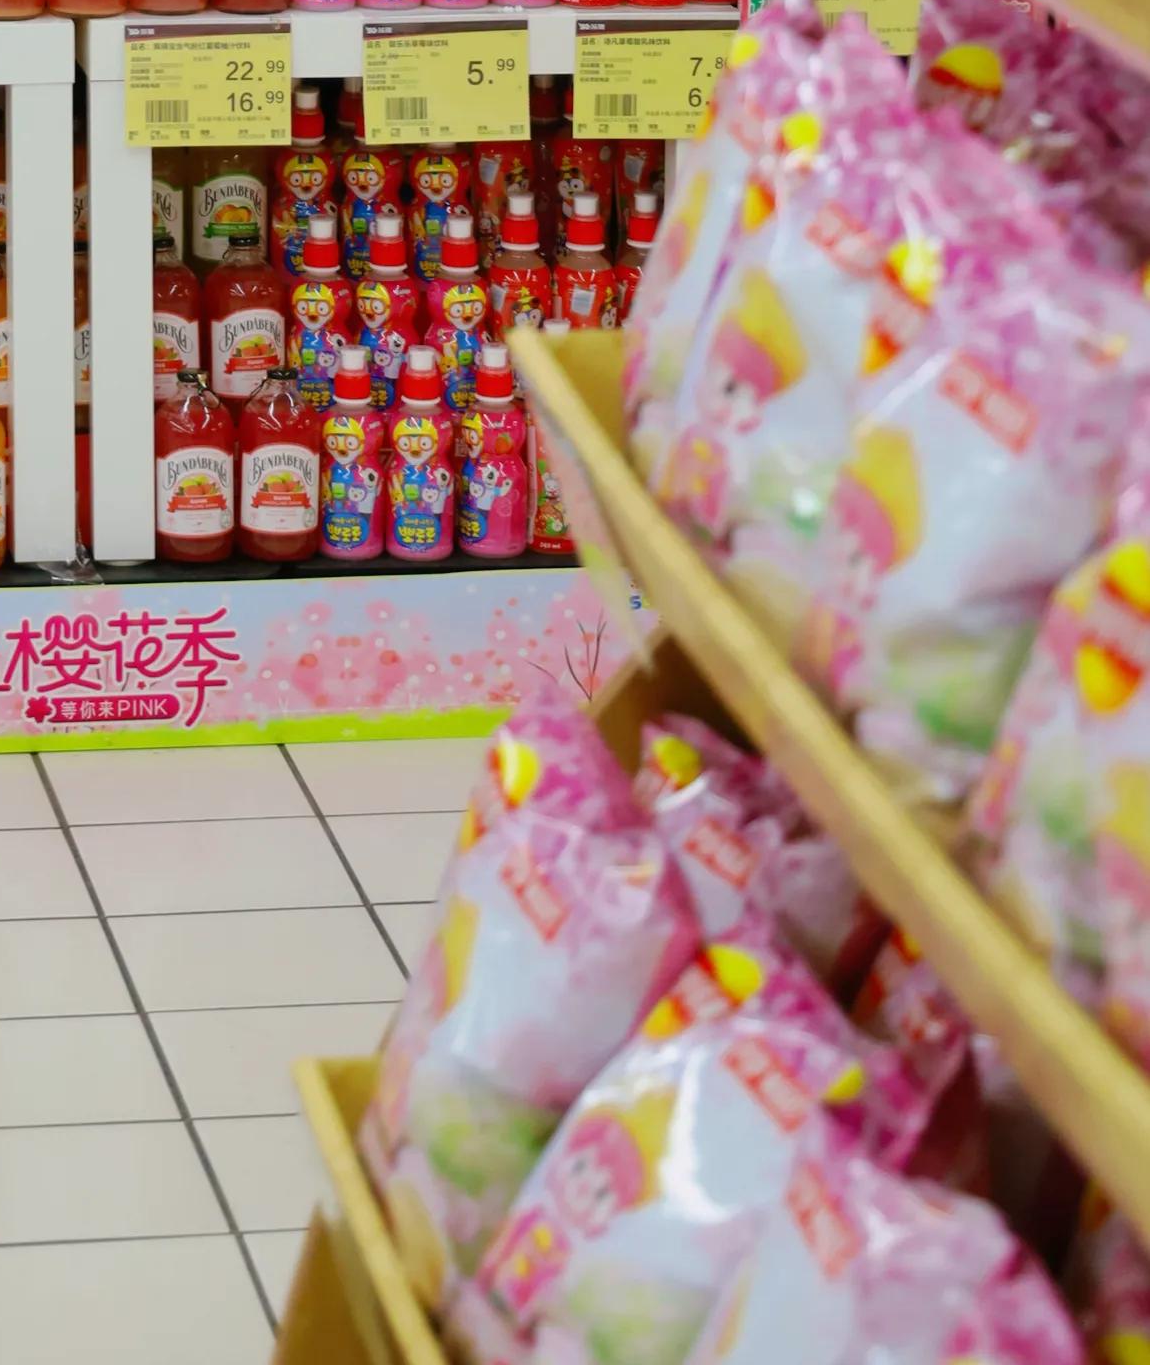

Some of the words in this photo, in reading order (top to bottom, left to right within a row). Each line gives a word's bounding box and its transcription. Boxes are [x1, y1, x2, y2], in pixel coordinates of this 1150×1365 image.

[225, 59, 285, 82] 22.99
[467, 58, 516, 85] 5.99
[226, 90, 285, 113] 16.99
